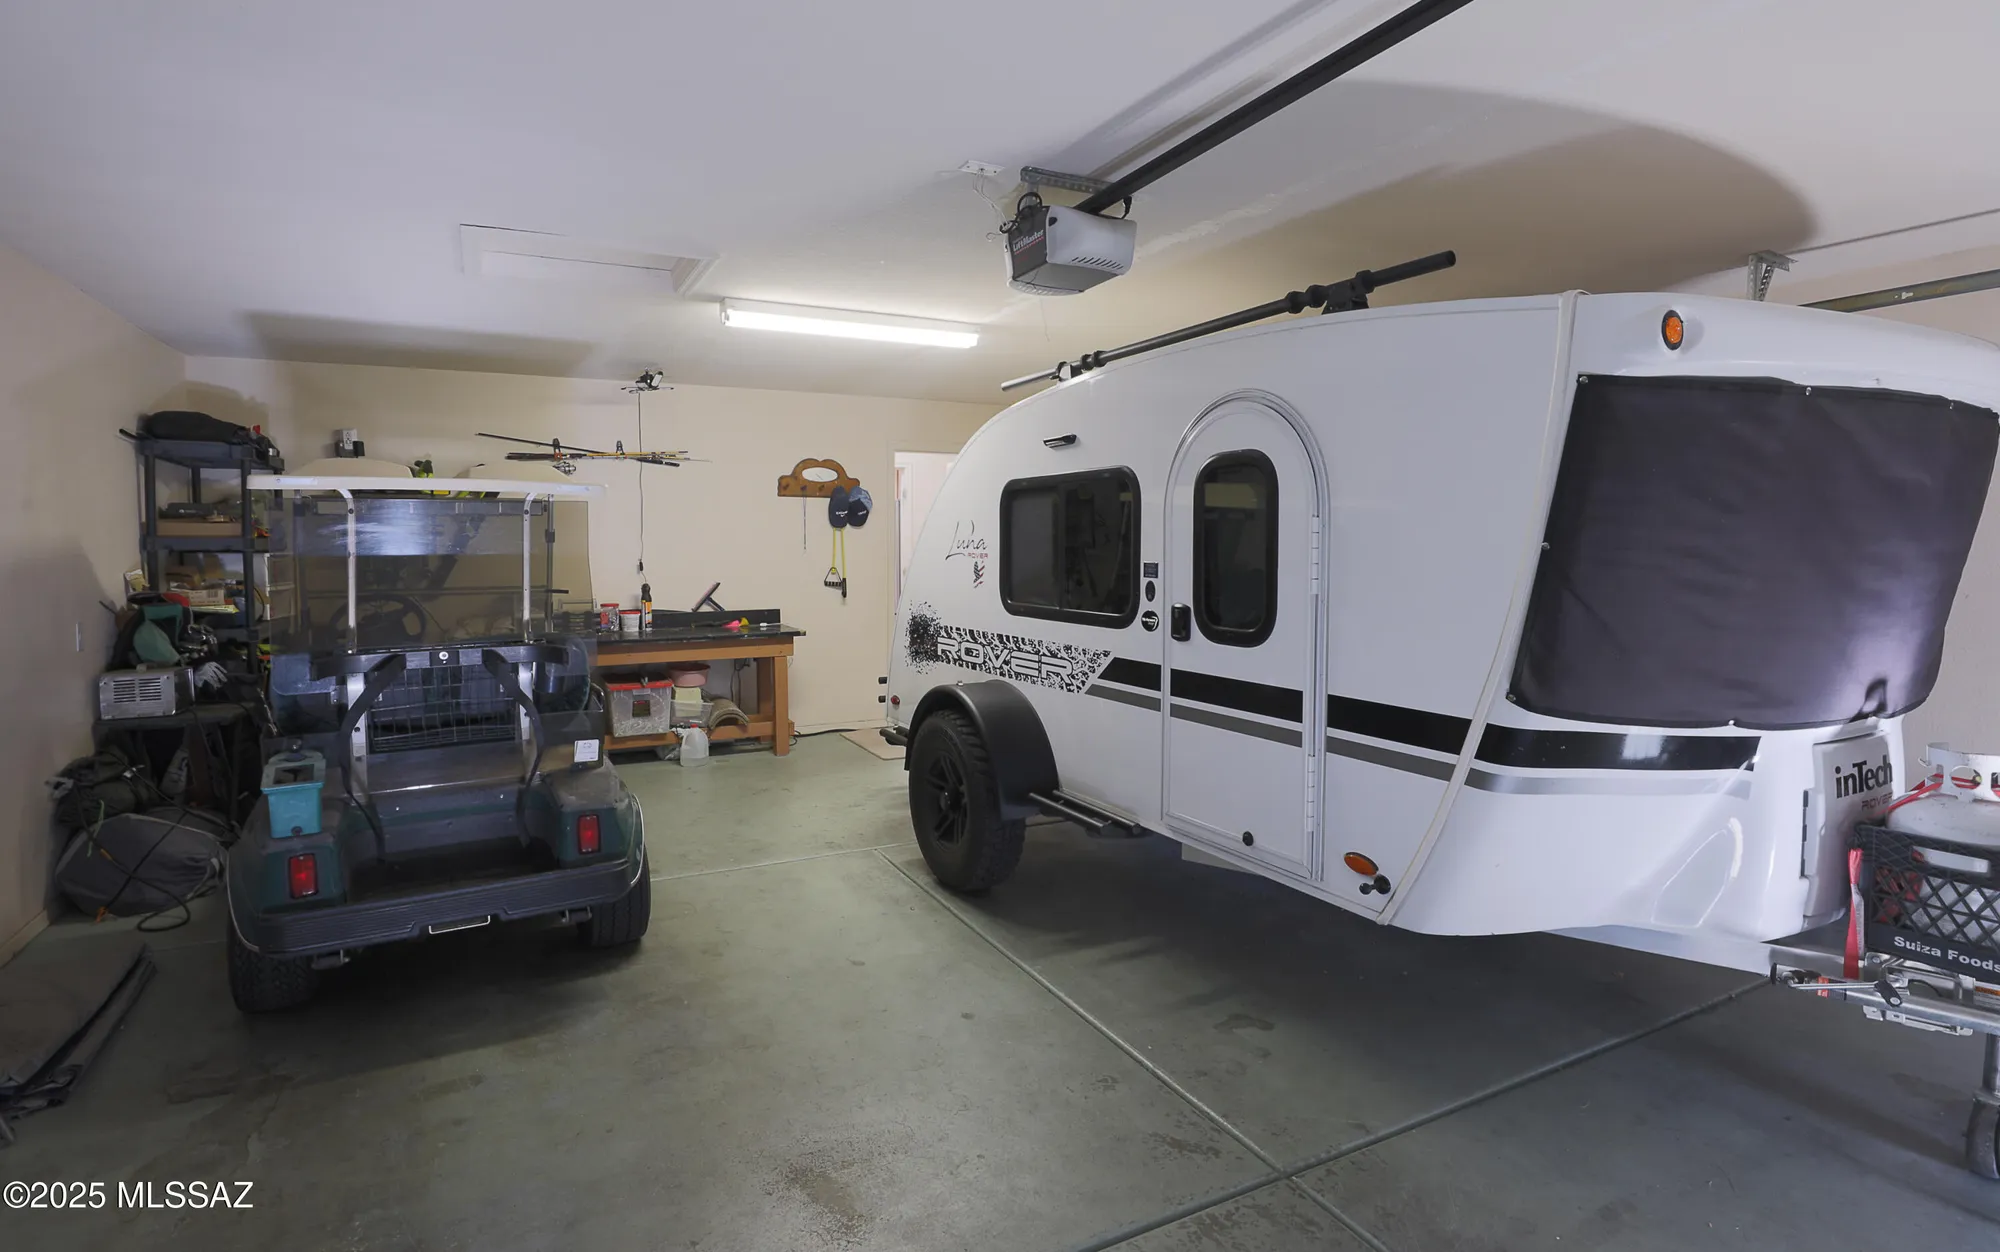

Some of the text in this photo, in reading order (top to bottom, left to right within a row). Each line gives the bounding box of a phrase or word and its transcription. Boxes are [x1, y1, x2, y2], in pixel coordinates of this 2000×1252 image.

[1013, 229, 1044, 252] LiftMaster
[945, 519, 987, 561] Luna
[937, 637, 1074, 683] ROVER
[1835, 754, 1893, 799] inTech
[1893, 936, 1941, 957] Suiza
